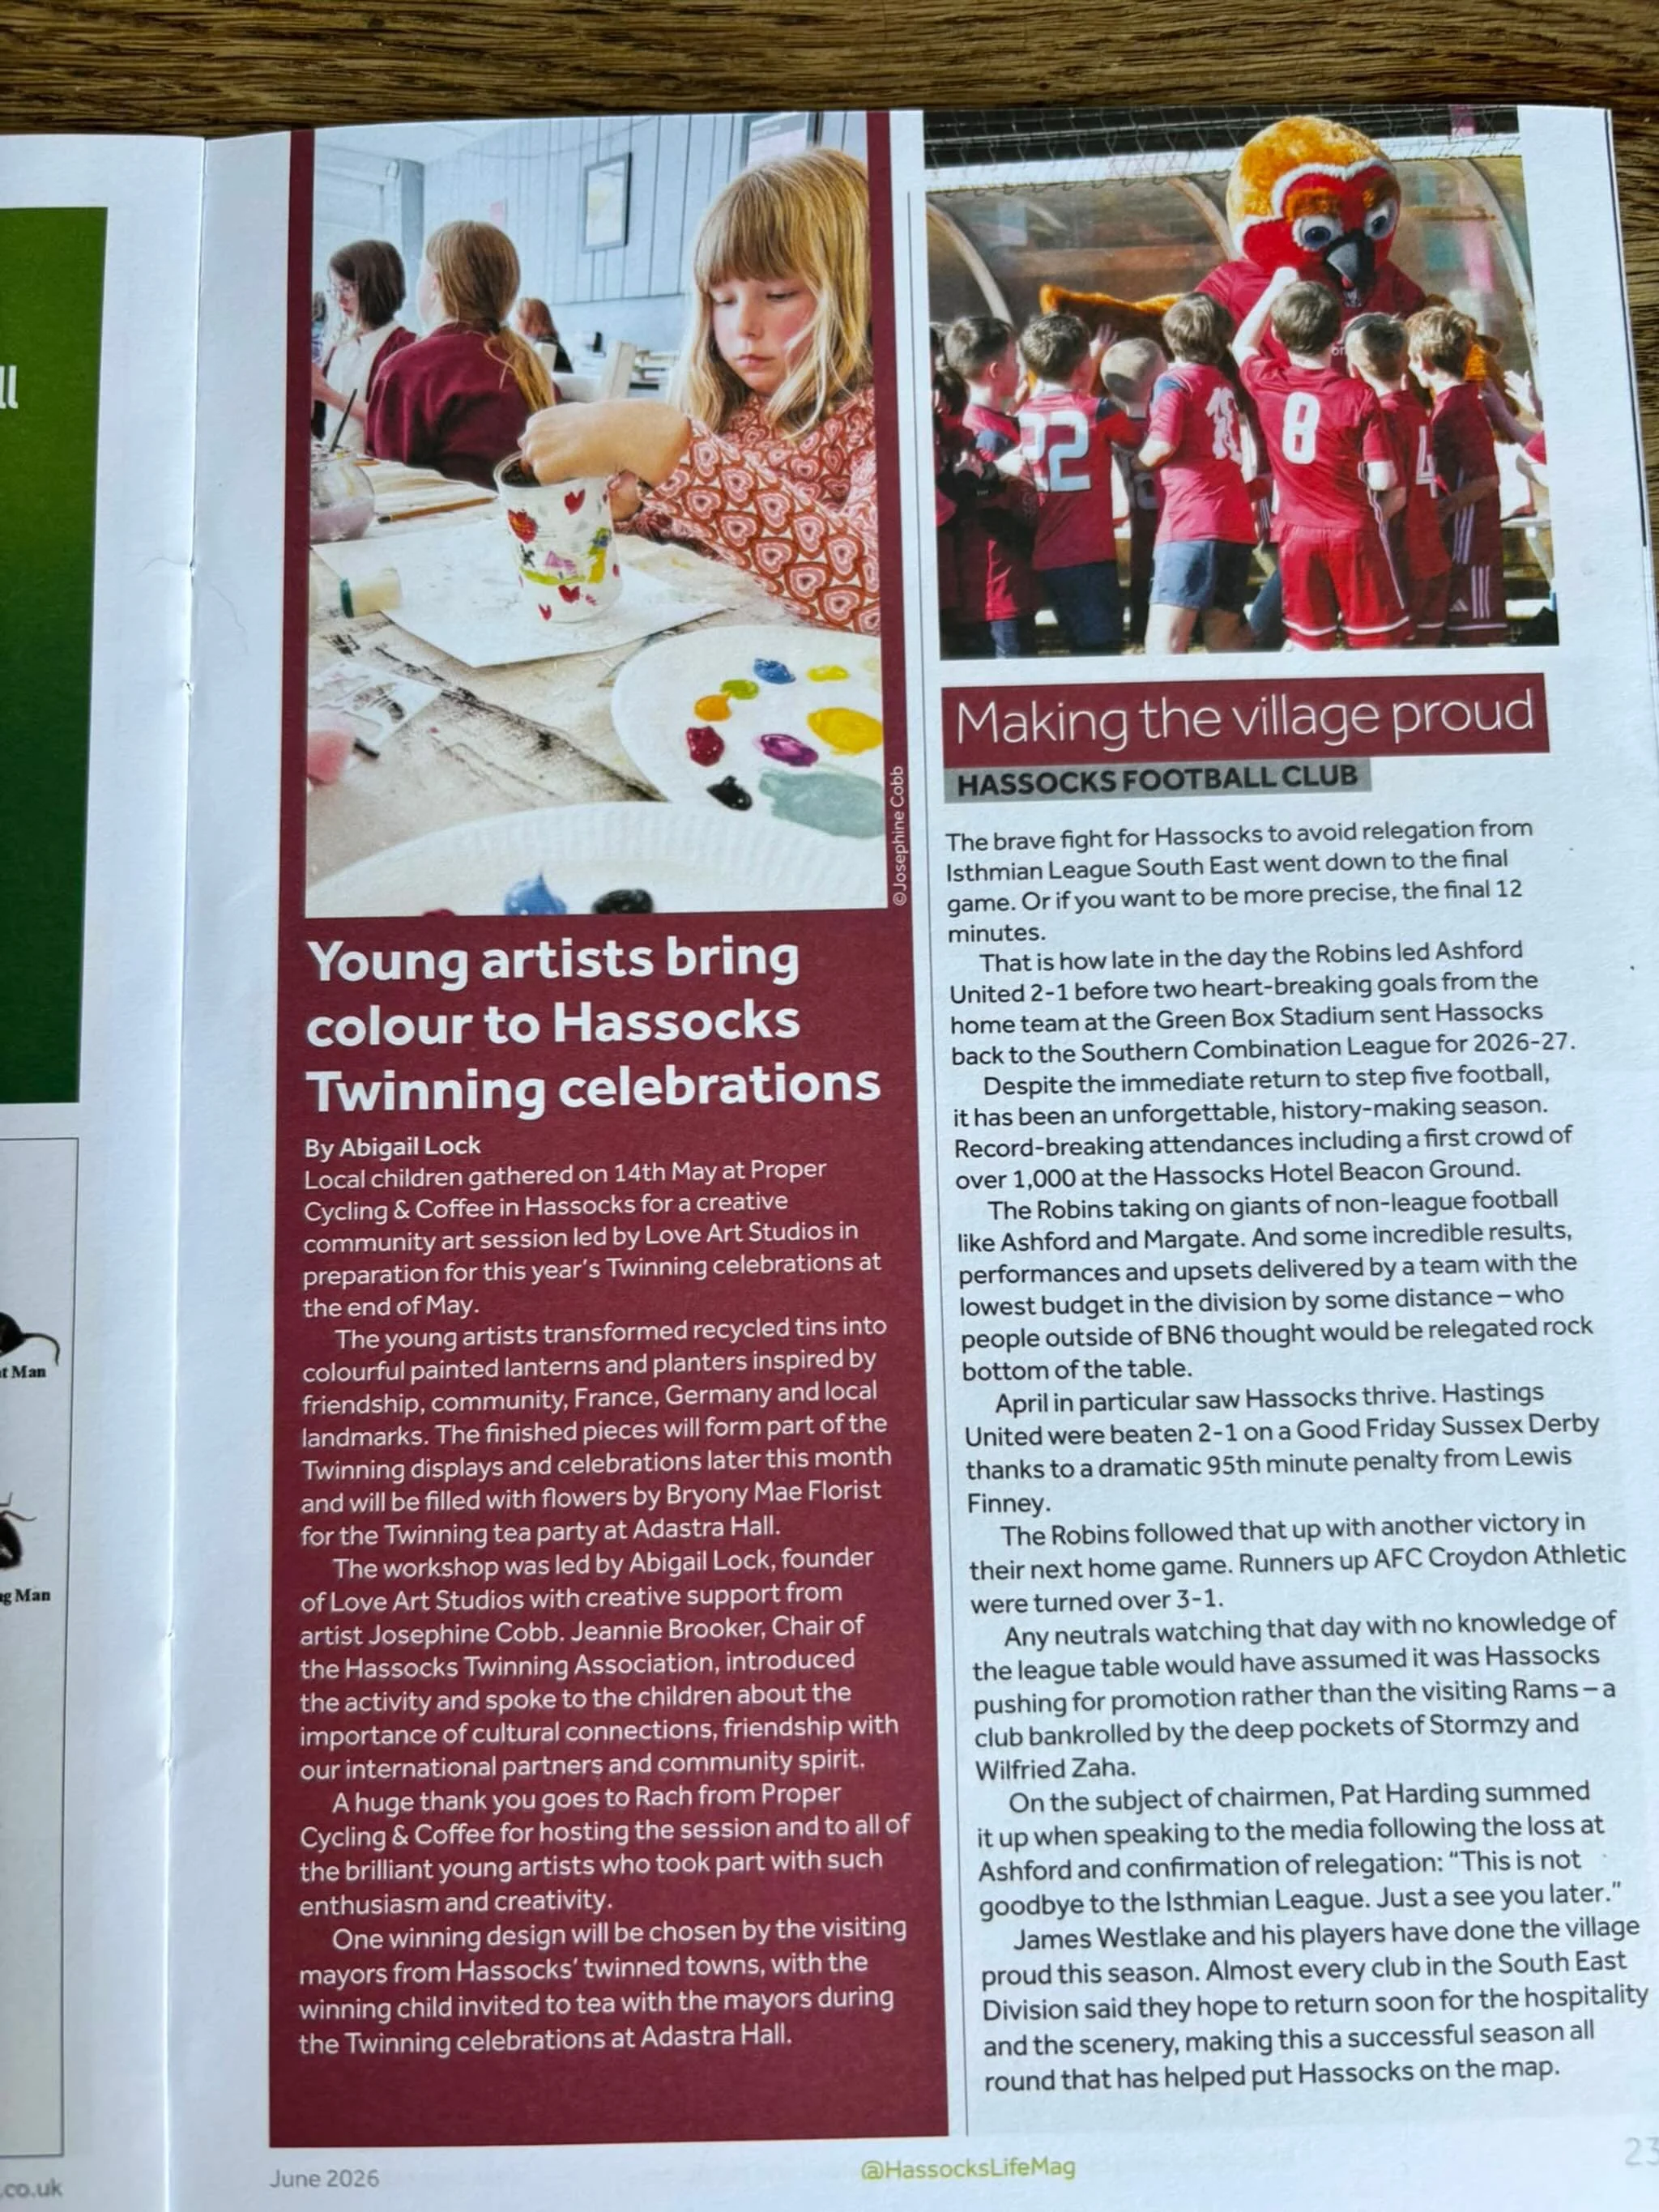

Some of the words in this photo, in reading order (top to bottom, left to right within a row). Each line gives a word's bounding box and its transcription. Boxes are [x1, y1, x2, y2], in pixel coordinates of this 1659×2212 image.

[1282, 392, 1320, 464] 8
[957, 701, 1128, 752] Making
[1139, 697, 1221, 738] the
[1232, 693, 1379, 745] village
[1392, 688, 1534, 744] proud
[890, 765, 905, 808] Cobb
[957, 770, 1119, 798] HASSOCKS
[1121, 766, 1279, 794] FOOTBALL
[1281, 764, 1359, 789] CLUB
[944, 832, 989, 852] The
[993, 831, 1056, 851] brave
[1059, 829, 1114, 855] fight
[1116, 827, 1150, 847] for
[1154, 825, 1264, 846] Hassocks
[1267, 825, 1293, 843] to
[1296, 821, 1358, 842] avoid
[1362, 820, 1475, 845] relegation
[1478, 817, 1533, 837] from
[948, 923, 1047, 944] minutes.
[308, 941, 467, 991] Young
[482, 938, 654, 979] artists
[667, 935, 799, 985] bring
[949, 982, 1026, 1005] United
[1030, 982, 1069, 1003] 2-1
[1074, 980, 1149, 1002] before
[1153, 980, 1197, 999] two
[1201, 974, 1373, 999] heart-breaking
[1377, 972, 1438, 999] goals
[1440, 971, 1496, 991] from
[1499, 970, 1539, 990] the
[307, 1004, 473, 1046] colour
[484, 1006, 539, 1044] to
[555, 999, 800, 1042] Hassocks
[951, 1045, 1005, 1066] back
[1008, 1046, 1034, 1065] to
[1037, 1043, 1077, 1064] the
[1081, 1042, 1188, 1063] Southern
[1192, 1038, 1342, 1060] Combination
[1347, 1036, 1431, 1060] League
[1435, 1033, 1469, 1054] for
[1473, 1031, 1576, 1053] 2026-27.
[305, 1068, 545, 1120] Twinning
[559, 1062, 881, 1107] celebrations
[953, 1108, 970, 1127] it
[974, 1107, 1014, 1127] has
[1018, 1106, 1075, 1127] been
[1080, 1109, 1107, 1125] an
[1112, 1101, 1277, 1128] unforgettable,
[1281, 1097, 1456, 1124] history-making
[1461, 1098, 1549, 1115] season.
[305, 1138, 335, 1163] By
[338, 1136, 420, 1162] Abigail
[424, 1134, 482, 1156] Lock
[304, 1169, 366, 1190] Local
[370, 1167, 463, 1188] children
[467, 1163, 574, 1192] gathered
[578, 1168, 608, 1183] on
[614, 1161, 666, 1183] 14th
[672, 1161, 719, 1186] May
[722, 1161, 746, 1180] at
[751, 1159, 828, 1183] Proper
[957, 1232, 996, 1253] like
[1000, 1230, 1091, 1252] Ashford
[1095, 1229, 1138, 1251] and
[1144, 1229, 1246, 1255] Margate.
[1251, 1226, 1298, 1247] And
[1303, 1230, 1368, 1247] some
[1372, 1221, 1484, 1245] incredible
[1488, 1220, 1572, 1242] results,
[303, 1264, 440, 1292] preparation
[443, 1261, 479, 1283] for
[482, 1260, 527, 1281] this
[604, 1255, 708, 1281] Twinning
[712, 1252, 855, 1275] celebrations
[858, 1251, 882, 1272] at
[11, 1365, 46, 1379] Man
[301, 1392, 425, 1418] friendship,
[430, 1389, 569, 1415] community,
[574, 1387, 660, 1409] France,
[665, 1383, 773, 1409] Germany
[777, 1380, 820, 1403] and
[825, 1379, 877, 1401] local
[300, 1491, 344, 1514] and
[348, 1491, 386, 1513] will
[390, 1490, 420, 1512] be
[424, 1489, 480, 1511] filled
[485, 1487, 536, 1510] with
[540, 1486, 628, 1508] flowers
[633, 1484, 662, 1512] by
[667, 1483, 749, 1511] Bryony
[754, 1481, 804, 1502] Mae
[808, 1478, 882, 1502] Florist
[967, 1492, 1051, 1519] Finney.
[968, 1559, 1026, 1582] their
[1030, 1558, 1084, 1580] next
[1088, 1557, 1157, 1579] home
[1161, 1558, 1234, 1582] game.
[1239, 1553, 1335, 1574] Runners
[1339, 1554, 1369, 1575] up
[1373, 1546, 1423, 1569] AFC
[1428, 1545, 1529, 1572] Croydon
[1533, 1543, 1627, 1565] Athletic
[15, 1588, 51, 1603] Man
[299, 1658, 340, 1680] the
[344, 1656, 458, 1679] Hassocks
[463, 1655, 569, 1681] Twinning
[574, 1652, 720, 1676] Association,
[726, 1647, 855, 1672] introduced
[299, 1763, 341, 1781] our
[345, 1755, 497, 1779] international
[501, 1755, 603, 1783] partners
[608, 1752, 652, 1775] and
[657, 1750, 794, 1776] community
[798, 1748, 865, 1776] spirit.
[975, 1758, 1066, 1782] Wilfried
[1071, 1756, 1137, 1779] Zaha.
[299, 1893, 440, 1917] enthusiasm
[444, 1890, 489, 1913] and
[493, 1888, 613, 1916] creativity.
[981, 1963, 1052, 1993] proud
[1056, 1962, 1102, 1985] this
[1107, 1965, 1201, 1984] season.
[1205, 1958, 1294, 1982] Almost
[1298, 1962, 1367, 1984] every
[1371, 1954, 1422, 1979] club
[1426, 1954, 1448, 1977] in
[1451, 1954, 1493, 1976] the
[1498, 1950, 1570, 1975] South
[1575, 1950, 1628, 1971] East
[297, 2032, 340, 2055] the
[343, 2031, 451, 2060] Twinning
[456, 2028, 607, 2053] celebrations
[610, 2027, 637, 2048] at
[640, 2024, 736, 2048] Adastra
[740, 2022, 792, 2046] Hall.
[984, 2068, 1056, 2093] round
[1060, 2068, 1112, 2091] that
[1116, 2066, 1160, 2090] has
[1164, 2064, 1246, 2093] helped
[1252, 2064, 1294, 2092] put
[1298, 2060, 1414, 2085] Hassocks
[1419, 2064, 1451, 2081] on
[1454, 2057, 1496, 2080] the
[1501, 2060, 1560, 2082] map.
[861, 2156, 1076, 2180] @HassocksLifeMag
[1623, 2136, 1659, 2167] 23
[270, 2170, 321, 2188] June
[327, 2169, 379, 2187] 2026
